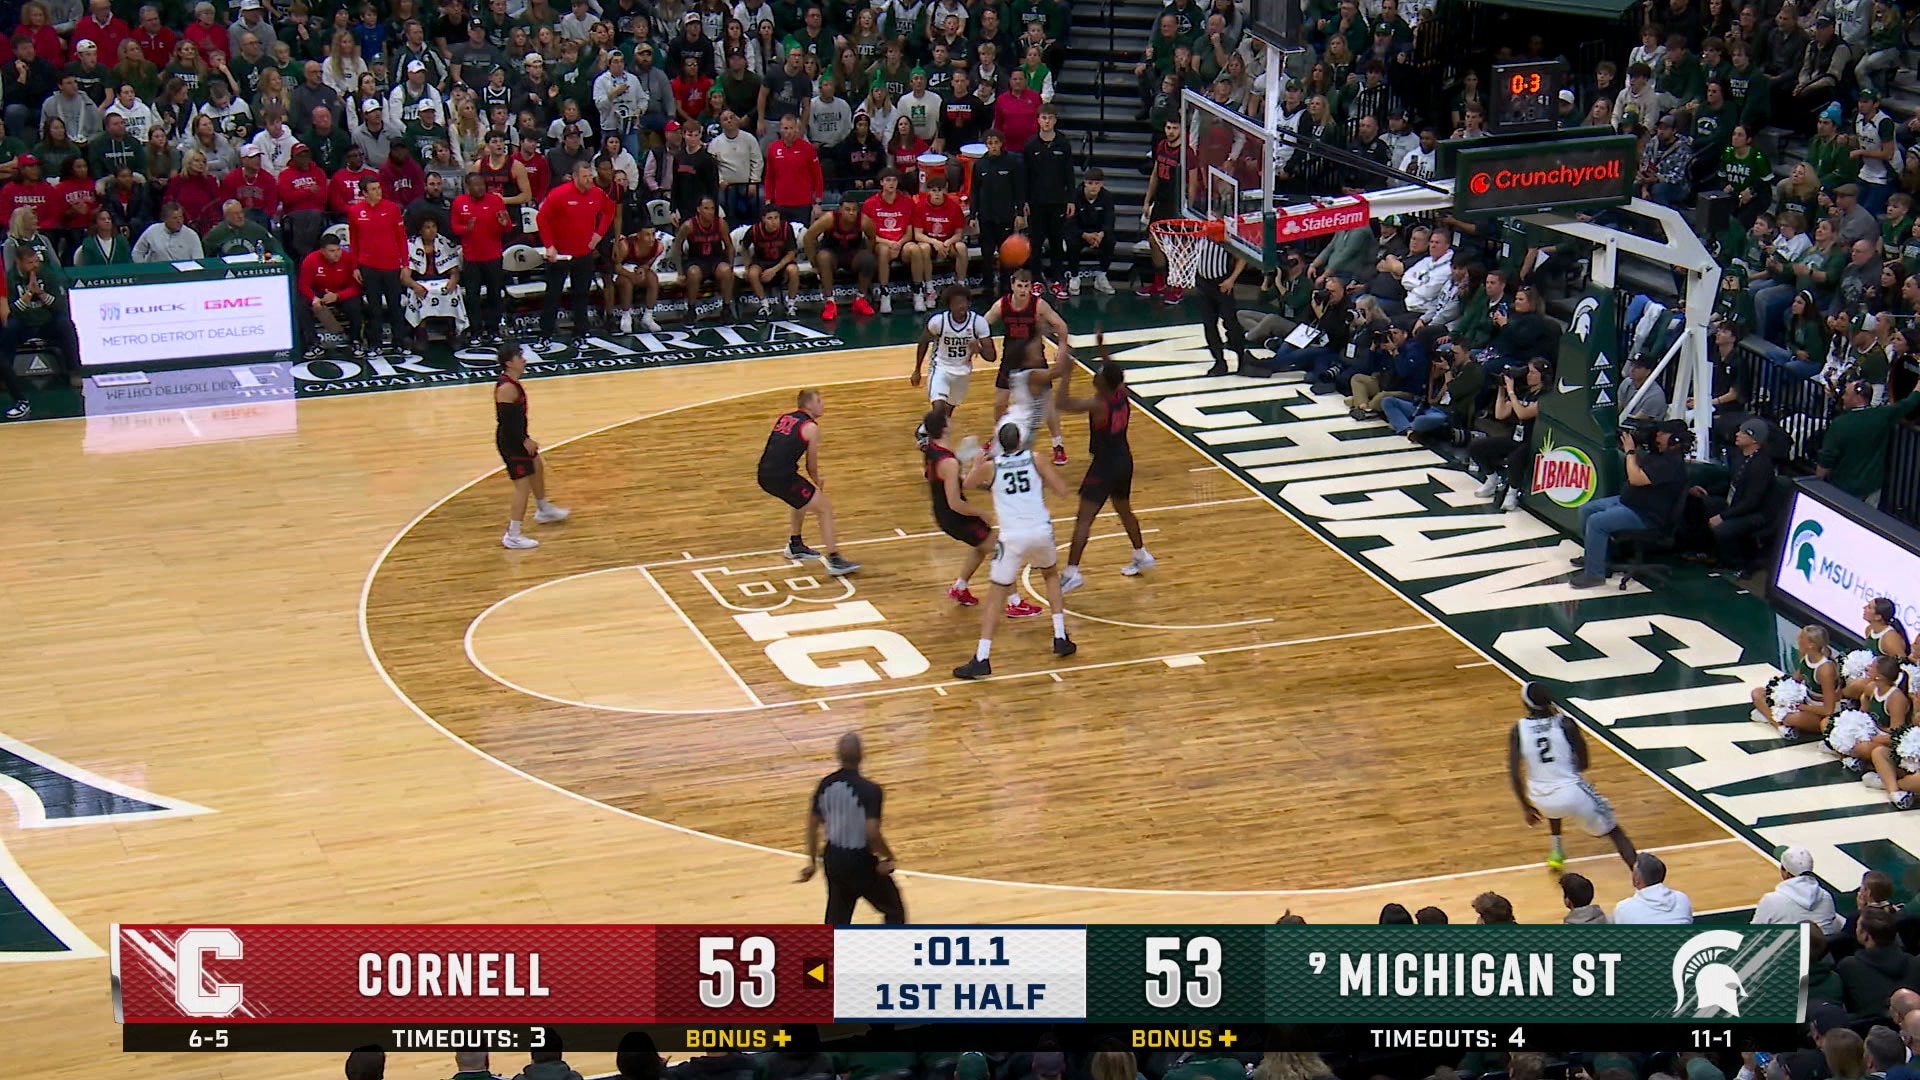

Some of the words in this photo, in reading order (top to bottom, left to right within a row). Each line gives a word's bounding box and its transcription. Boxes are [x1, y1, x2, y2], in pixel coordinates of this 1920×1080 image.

[857, 45, 874, 56] TATE
[1495, 159, 1620, 189] Crunchyroll
[1725, 163, 1752, 176] GAME
[1727, 174, 1746, 184] DAY
[14, 195, 46, 204] CORNELL
[86, 277, 135, 286] ACRISURE
[235, 267, 282, 277] ACRISURE
[125, 302, 187, 314] BUICK
[203, 296, 263, 310] GMC
[657, 302, 689, 312] Rocket
[102, 333, 149, 347] METRO
[151, 329, 205, 344] DETROIT
[208, 325, 265, 339] DEALERS
[228, 353, 448, 389] FOR
[454, 320, 834, 369] SPARTA
[948, 346, 967, 358] 55
[236, 386, 299, 398] THE
[304, 374, 425, 394] CAPITAL
[582, 357, 634, 369] FOR
[642, 350, 696, 364] MSU
[702, 338, 845, 358] ATHLETICS
[1067, 323, 1651, 616] MICHIGAN
[1531, 454, 1592, 493] LIBMAN
[1003, 469, 1031, 495] 35
[1819, 556, 1854, 590] MSU
[1537, 737, 1555, 763] 2
